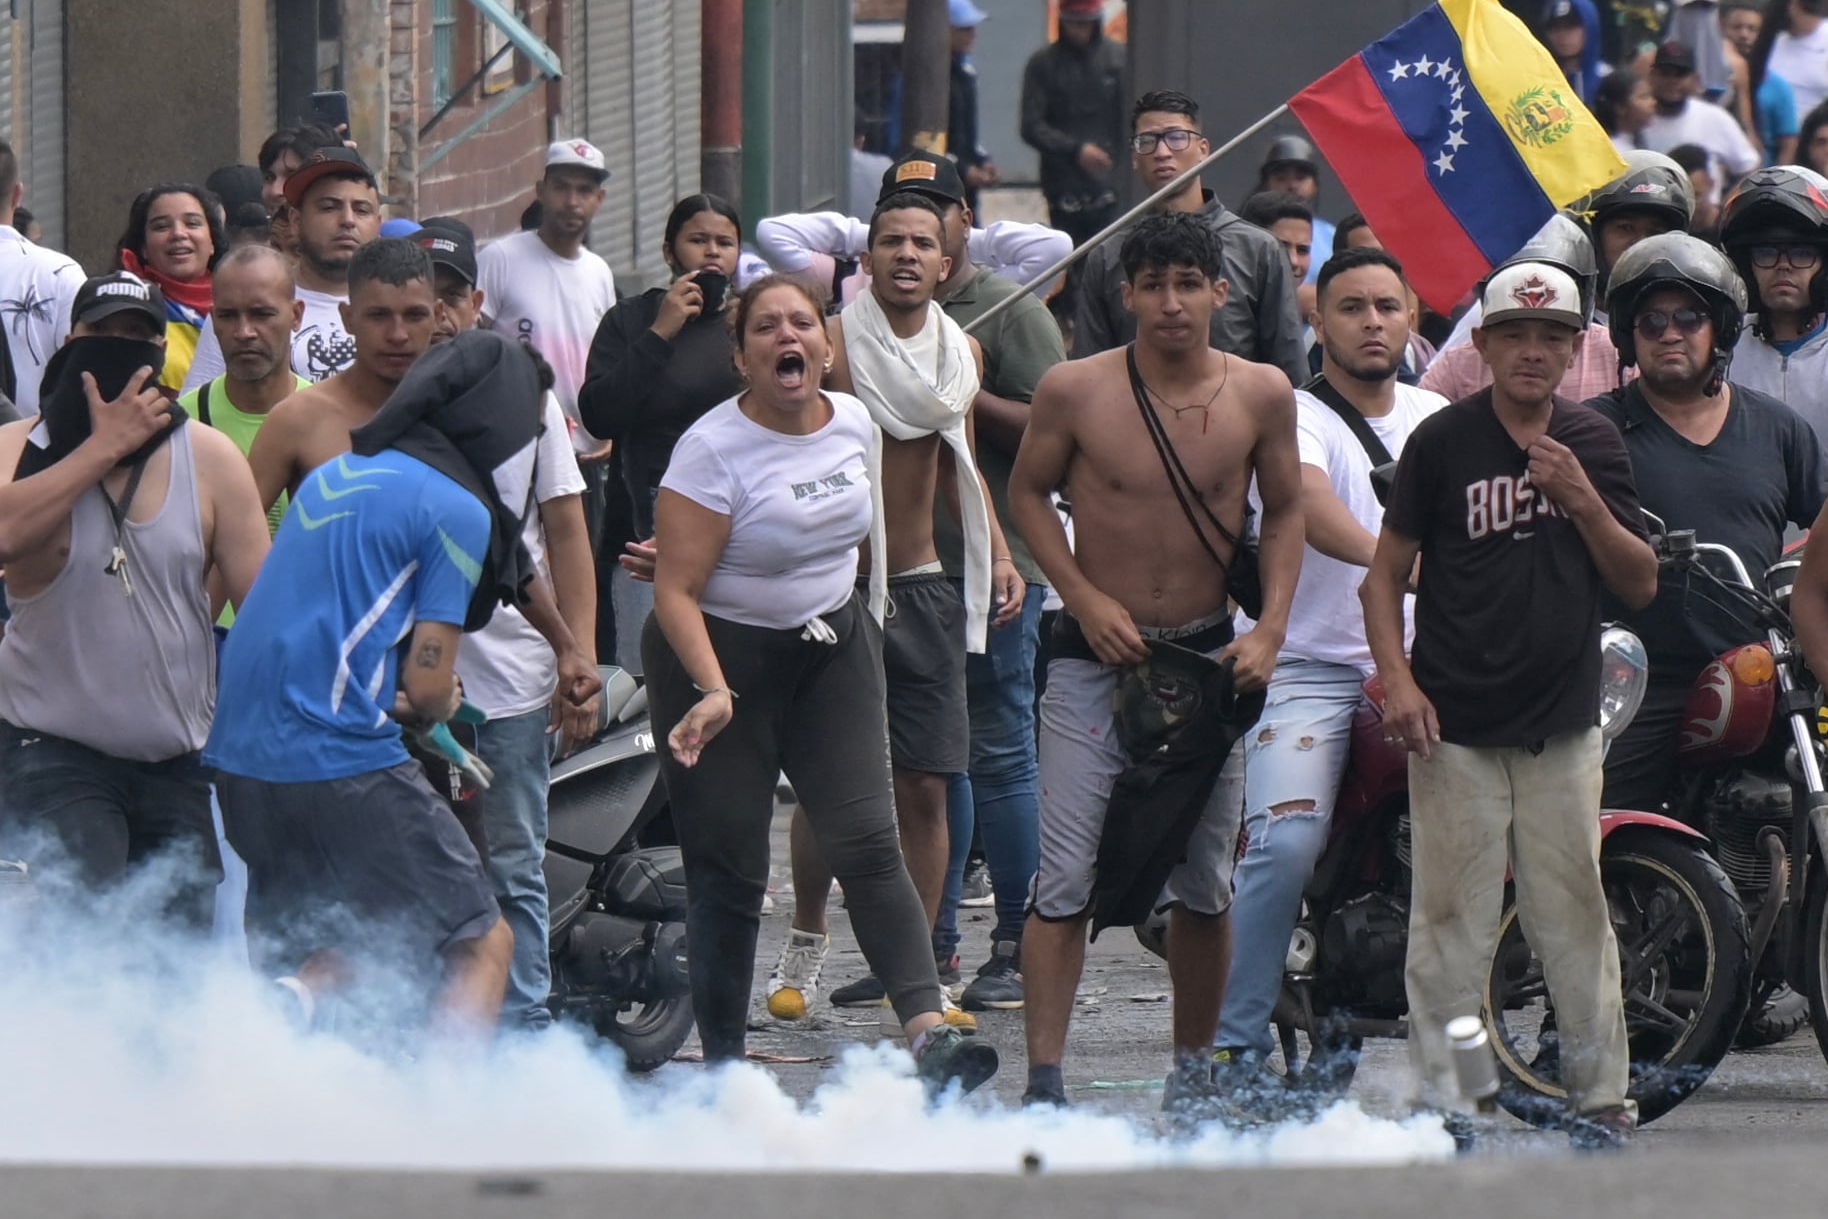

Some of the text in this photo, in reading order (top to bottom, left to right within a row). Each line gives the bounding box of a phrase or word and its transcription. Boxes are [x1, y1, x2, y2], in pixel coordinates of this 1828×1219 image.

[96, 283, 145, 300] PUMA
[791, 471, 854, 500] NEW YORK
